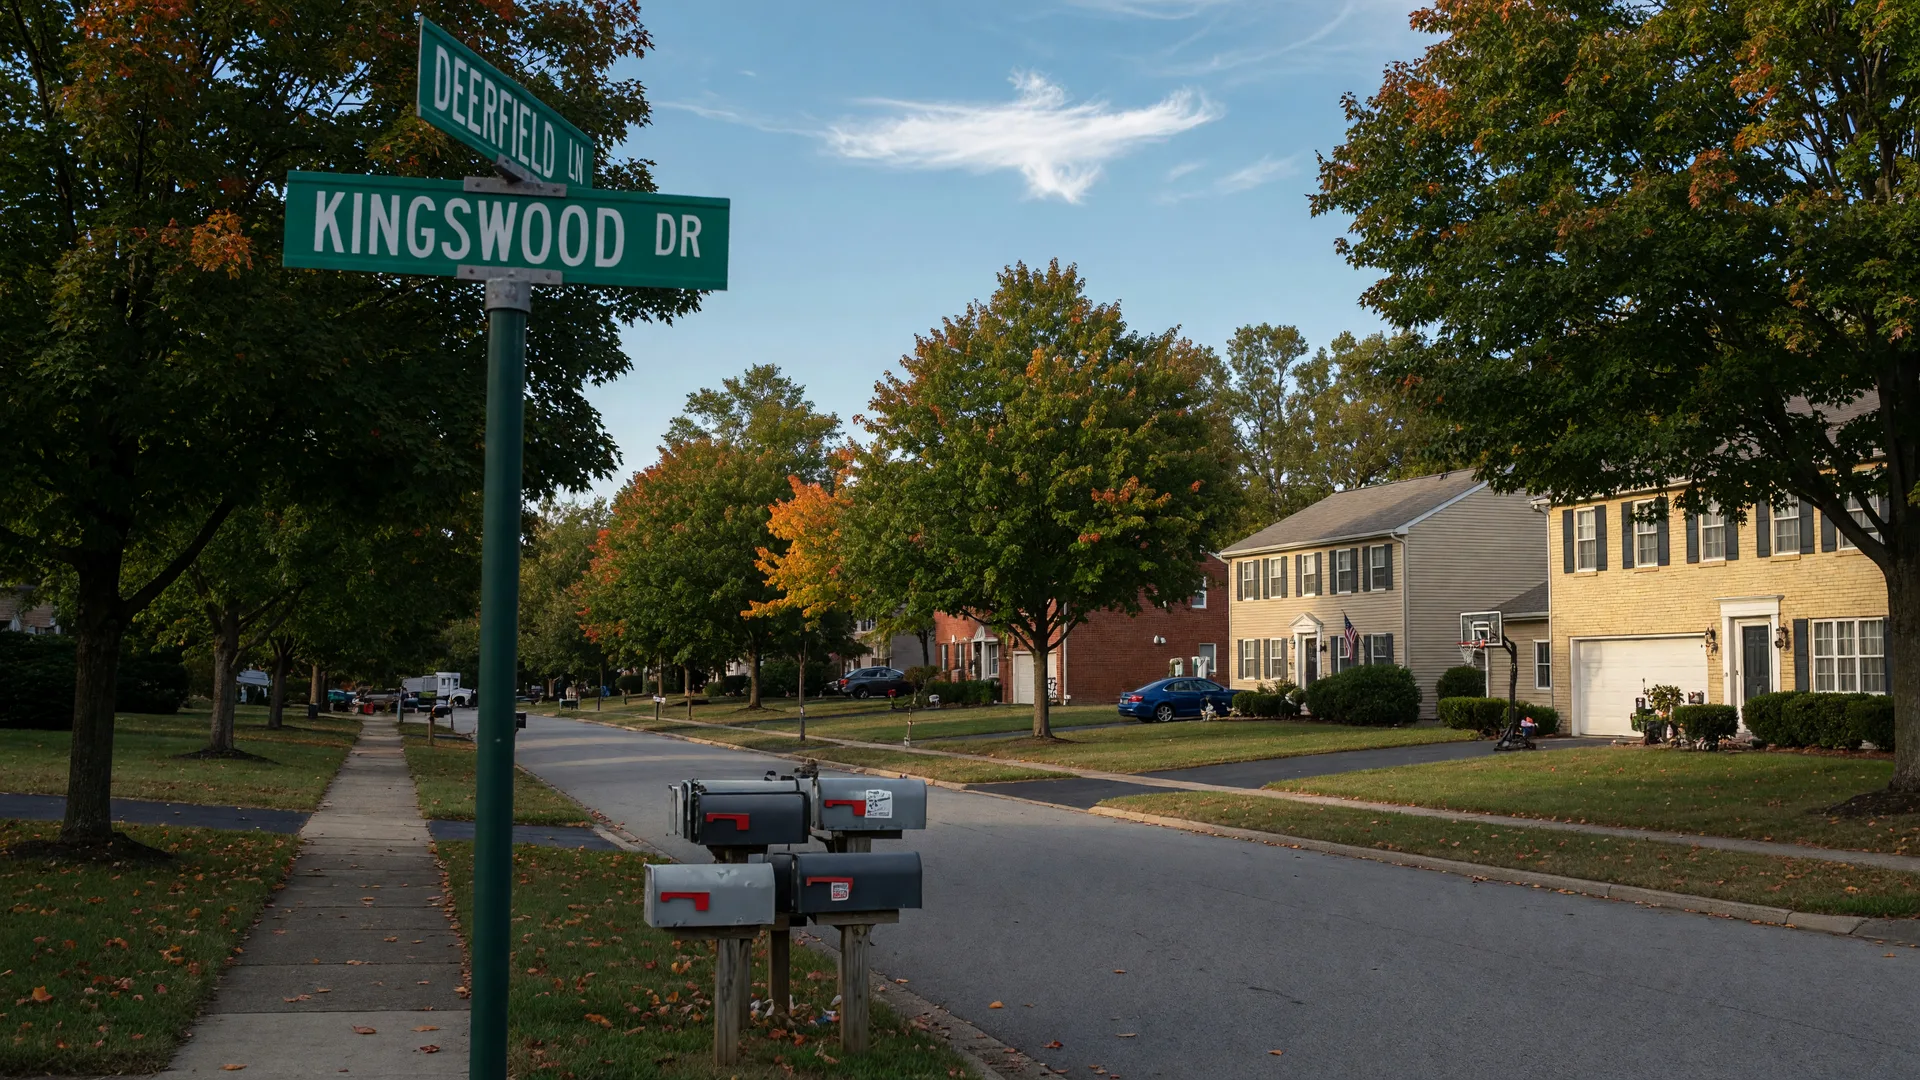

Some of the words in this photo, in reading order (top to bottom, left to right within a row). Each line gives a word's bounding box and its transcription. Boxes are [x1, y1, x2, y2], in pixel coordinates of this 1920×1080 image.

[434, 44, 555, 179] DEERFIELD
[568, 137, 584, 185] LN
[313, 190, 625, 268] KINGSWOOD
[655, 213, 702, 258] DR
